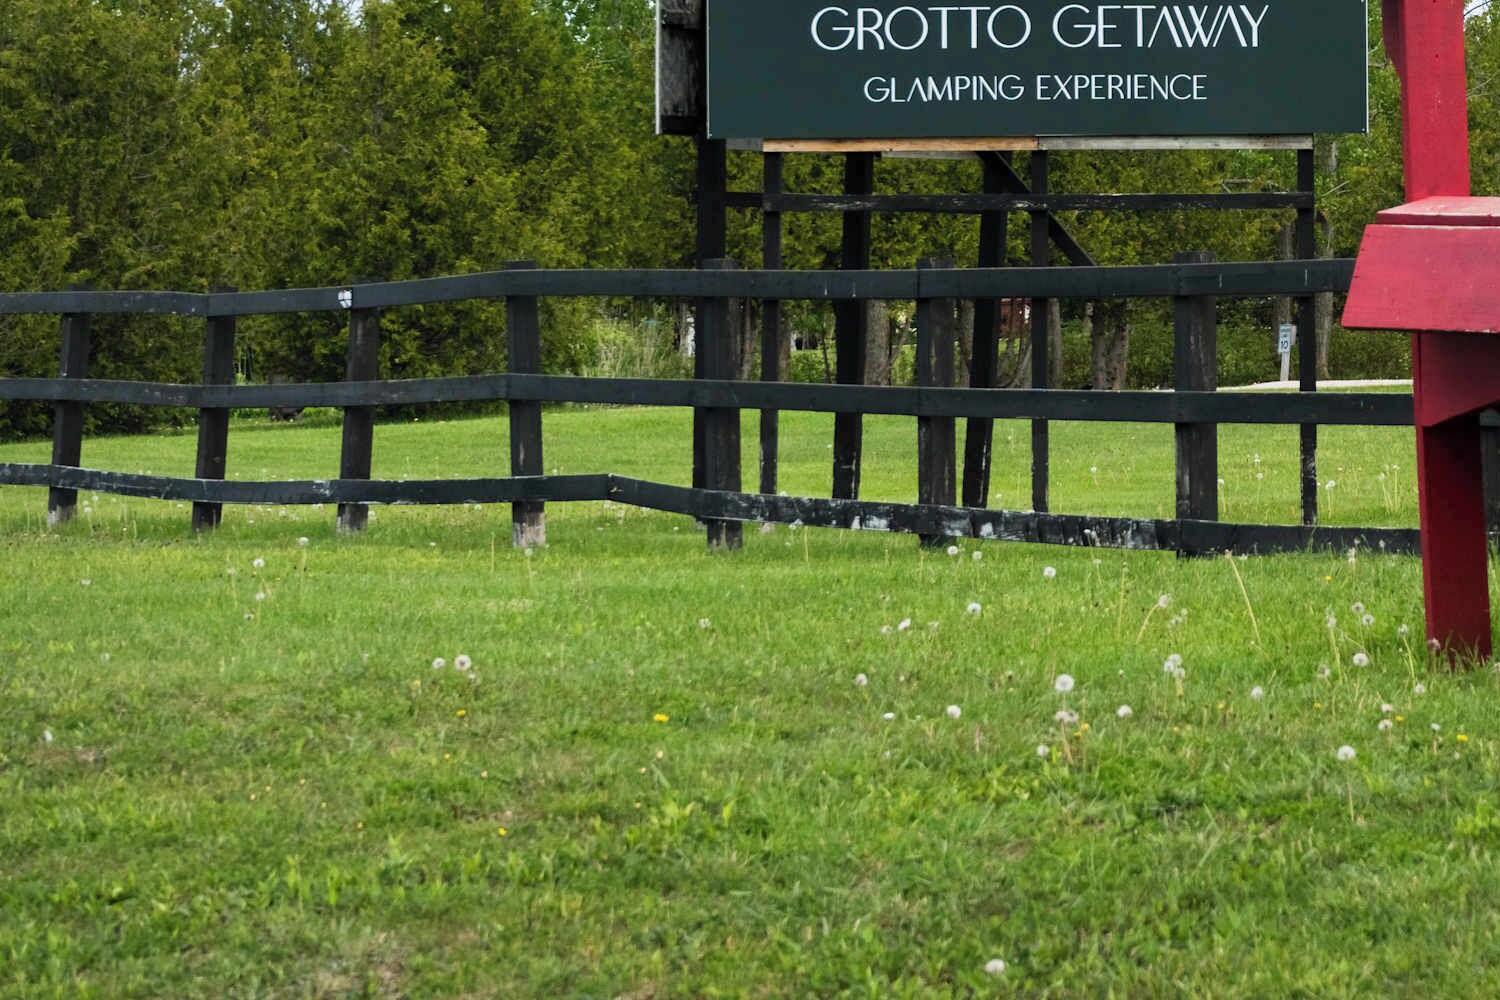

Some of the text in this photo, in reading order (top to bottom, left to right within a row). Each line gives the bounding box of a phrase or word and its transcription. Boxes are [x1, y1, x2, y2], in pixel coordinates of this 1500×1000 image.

[810, 3, 1270, 51] GROTTO GETAWAY
[863, 73, 1209, 103] GLAMPING EXPERIENCE
